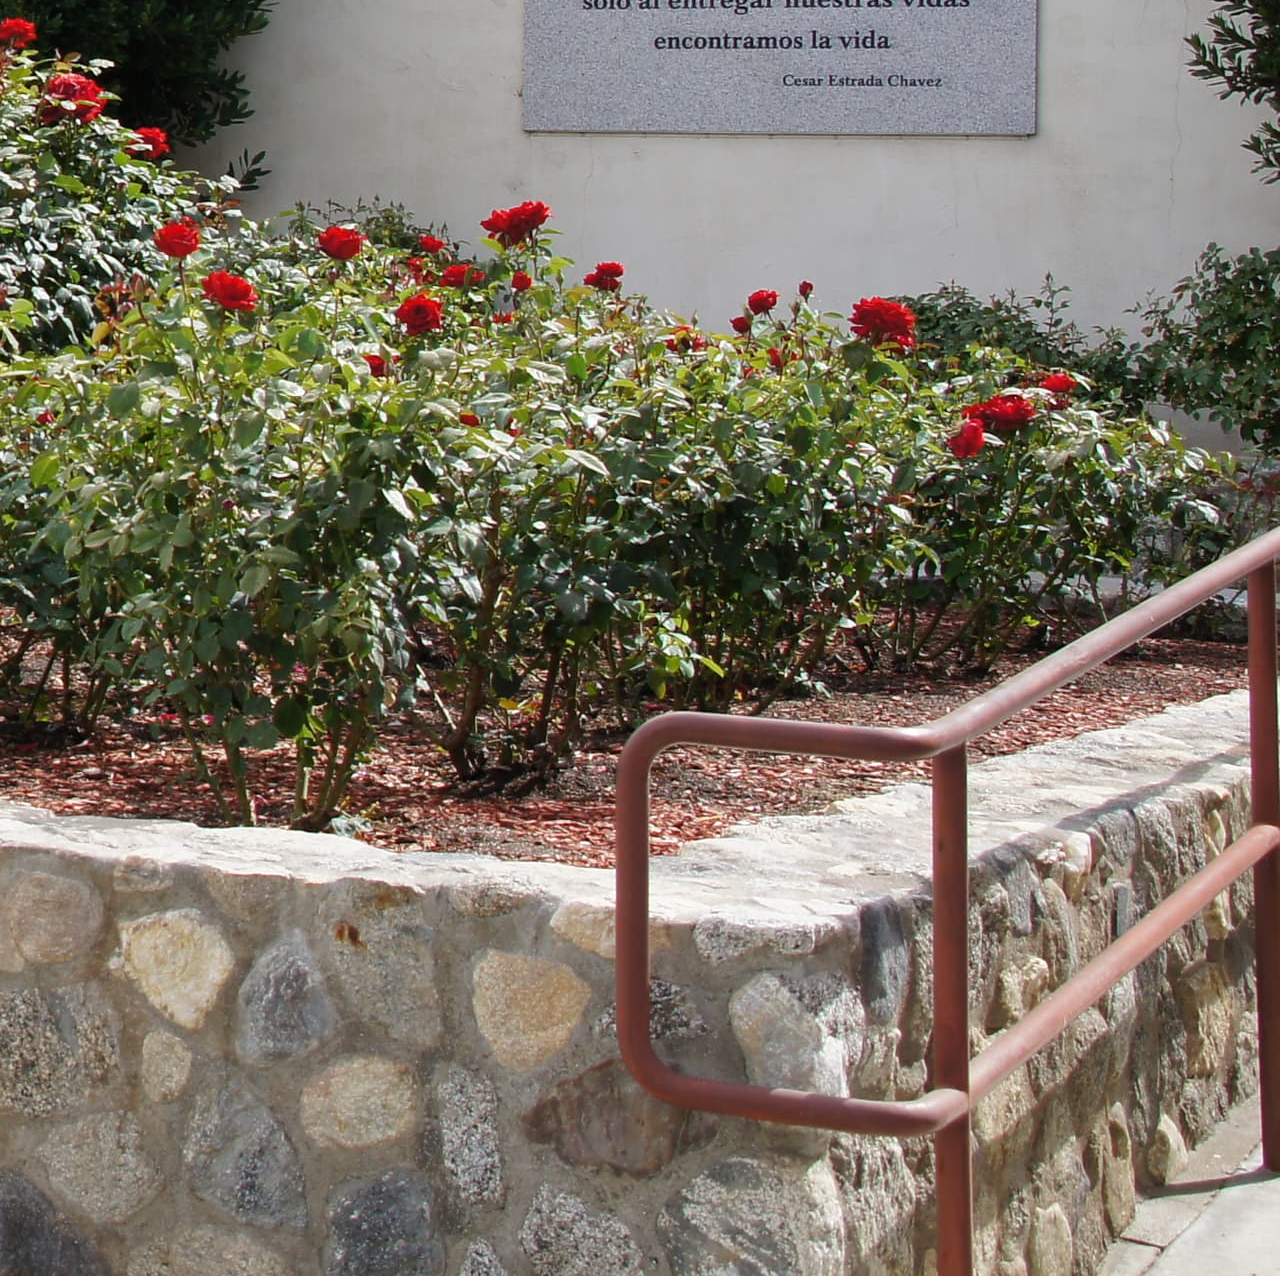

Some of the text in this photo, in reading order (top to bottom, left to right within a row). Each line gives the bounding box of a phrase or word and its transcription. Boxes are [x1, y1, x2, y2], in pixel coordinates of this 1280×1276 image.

[654, 29, 892, 50] encontramos la vida
[782, 73, 943, 88] Cesar Estrada Chavez
